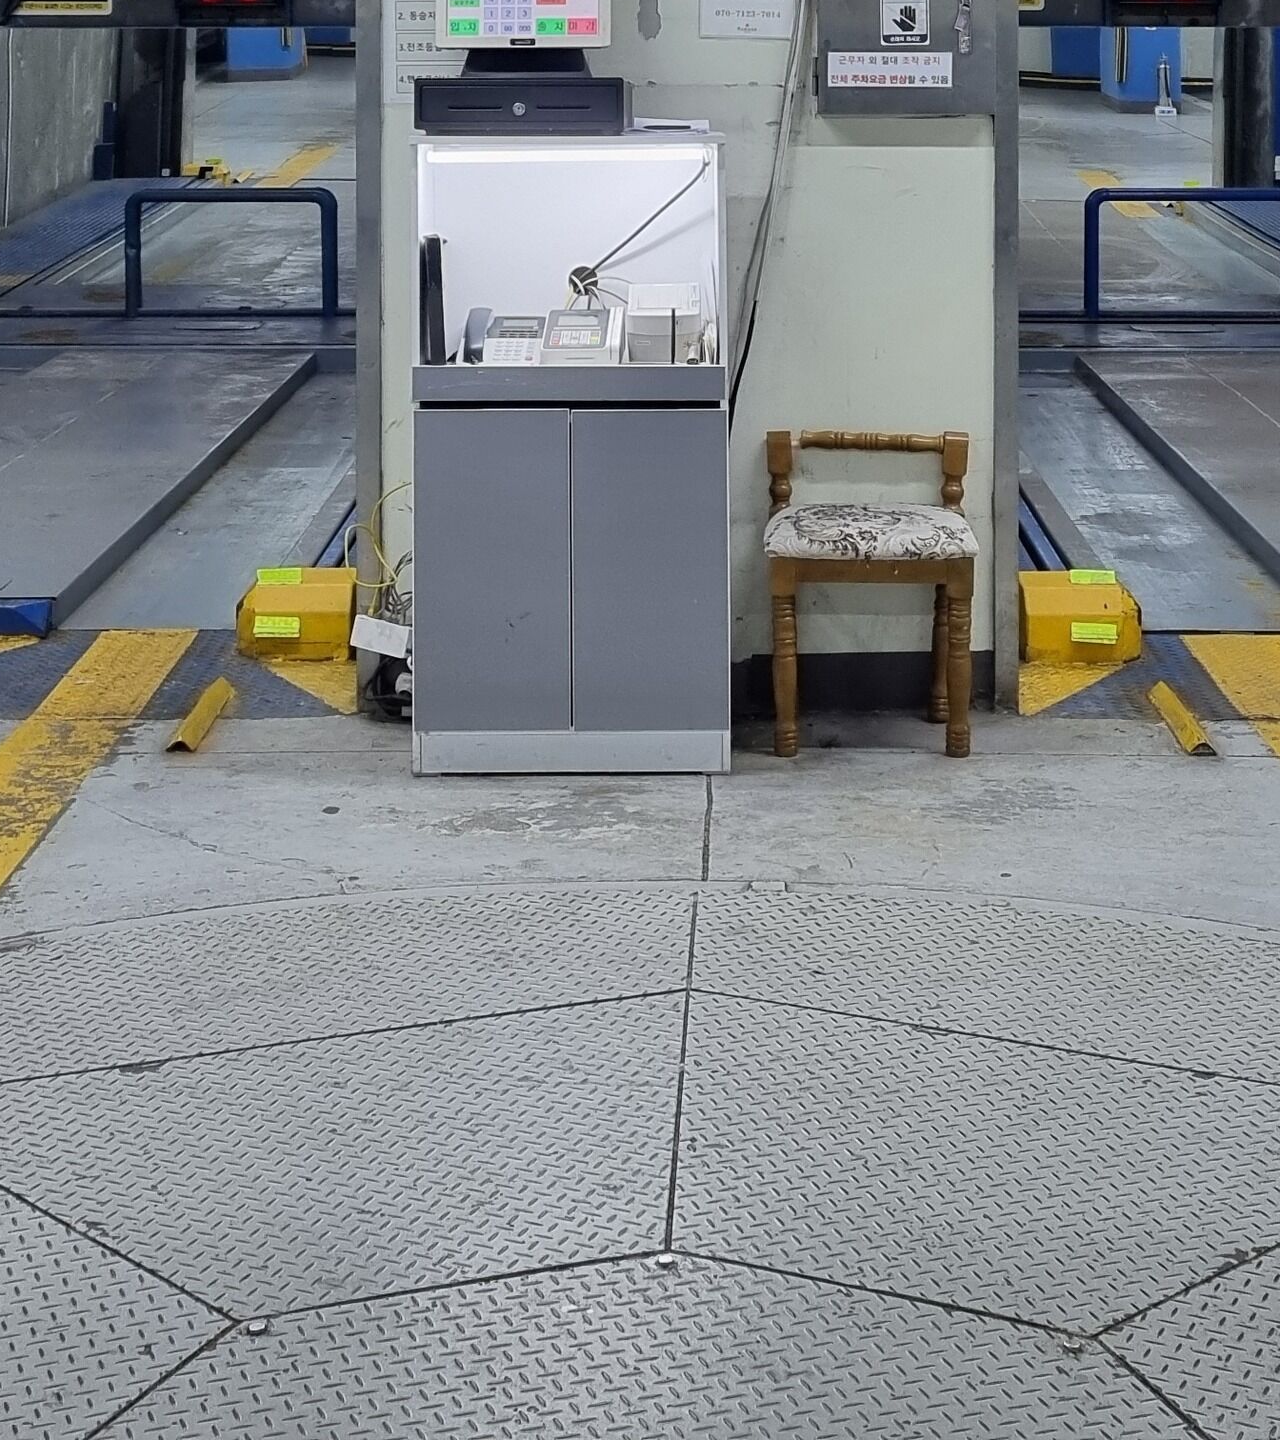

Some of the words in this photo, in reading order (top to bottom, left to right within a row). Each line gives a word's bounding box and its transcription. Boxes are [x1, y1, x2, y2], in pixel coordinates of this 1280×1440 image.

[838, 56, 864, 65] 근무자
[868, 56, 877, 65] 외
[881, 56, 898, 65] 절대
[902, 55, 919, 65] 조작
[923, 55, 940, 65] 금지
[851, 75, 886, 85] 주차요금
[919, 75, 928, 85] 수
